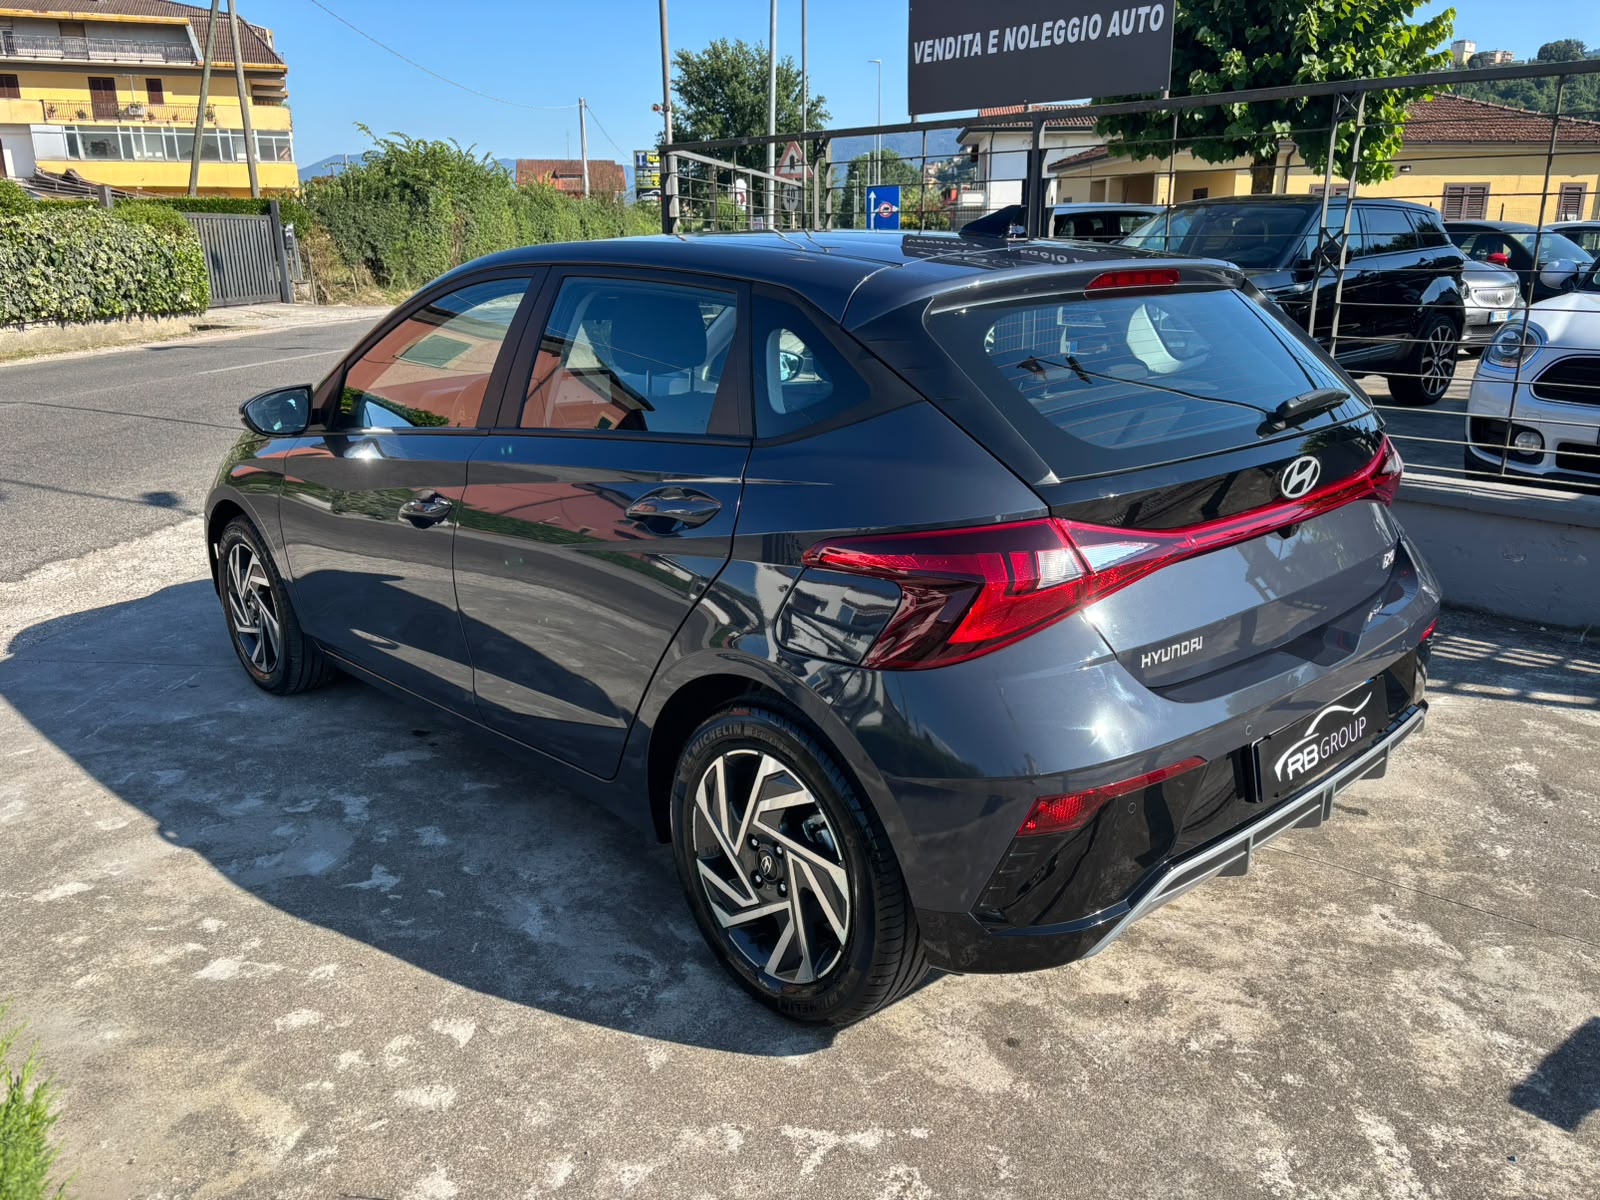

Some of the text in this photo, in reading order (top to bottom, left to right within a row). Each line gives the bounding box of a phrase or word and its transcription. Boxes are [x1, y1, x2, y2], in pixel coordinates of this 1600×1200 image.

[914, 3, 1165, 64] VENDITA E NOLEGGIO AUTO
[1141, 636, 1203, 668] HYUNDAI
[691, 724, 741, 756] MICHELIN
[1320, 717, 1366, 759] GROUP
